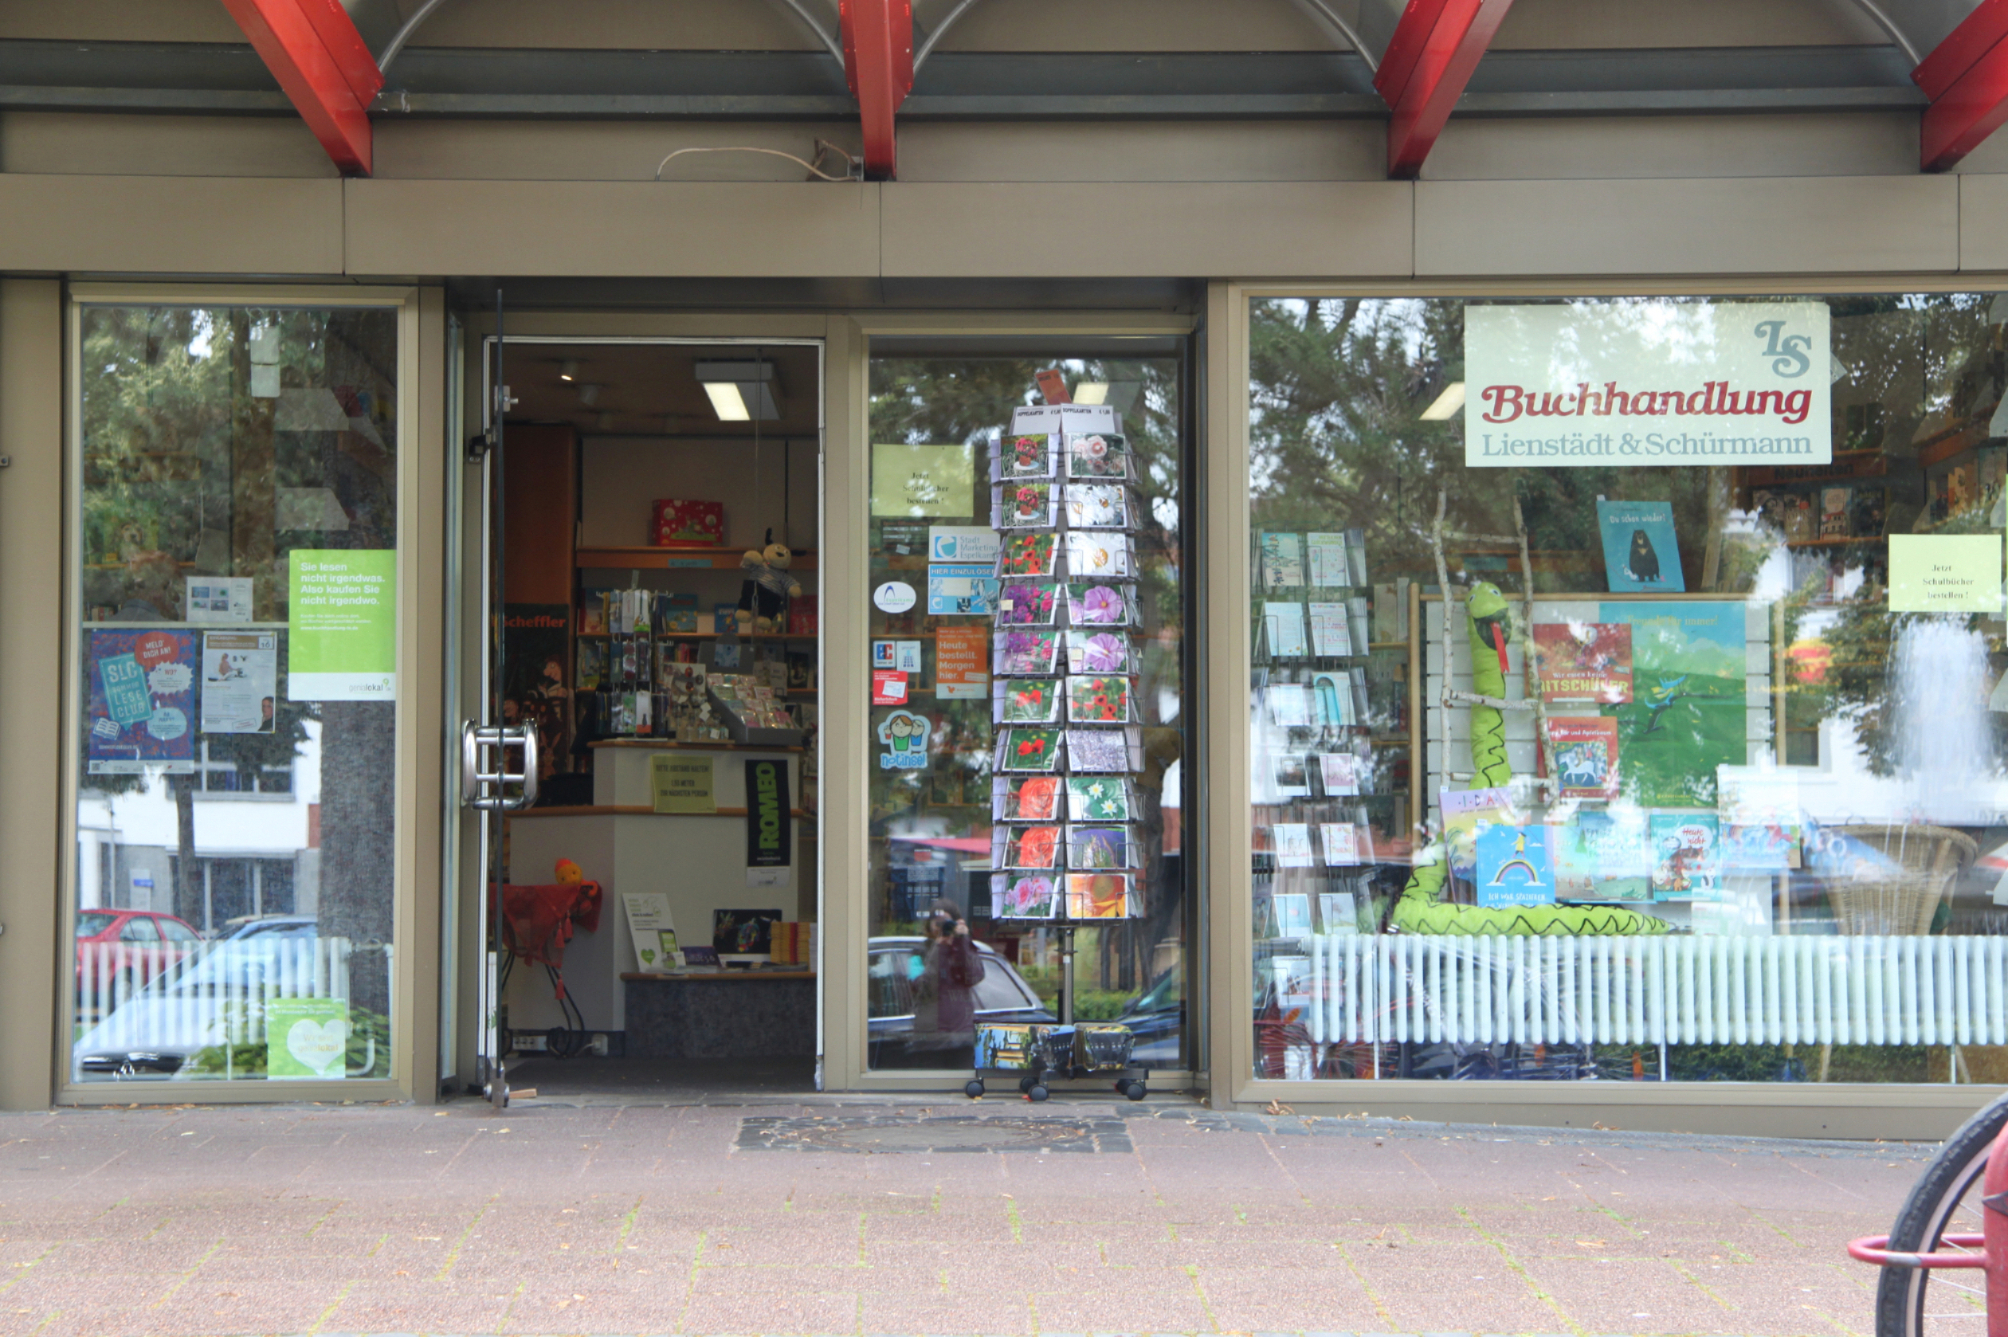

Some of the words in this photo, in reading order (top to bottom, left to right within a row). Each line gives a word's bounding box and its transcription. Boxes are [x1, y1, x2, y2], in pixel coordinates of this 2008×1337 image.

[1481, 381, 1812, 424] Buchhandlung
[1482, 433, 1615, 456] Lienstädt
[1619, 433, 1643, 456] &
[1645, 432, 1813, 456] Schürmann
[911, 472, 929, 480] Jetzt
[1621, 514, 1640, 523] schon
[1641, 512, 1666, 522] wieder!
[960, 535, 980, 544] Stadt
[960, 543, 999, 553] Marketing
[300, 562, 317, 571] Sie
[319, 562, 347, 571] lesen
[1931, 564, 1952, 572] Jetzt
[301, 573, 327, 582] nicht
[329, 573, 385, 584] irgendwas.
[1922, 577, 1974, 585] Schulbücher
[300, 585, 324, 594] Also
[326, 585, 361, 594] kaufen
[363, 585, 380, 594] Sie
[1927, 591, 1963, 599] bestellen
[301, 596, 327, 605] nicht
[329, 596, 380, 607] irgendwo.
[504, 615, 566, 628] Scheffler
[1684, 615, 1719, 626] immer!
[939, 641, 968, 650] Heute
[143, 648, 161, 659] DICH
[160, 646, 172, 656] AN!
[939, 651, 978, 659] bestellt.
[939, 661, 975, 671] Morgen
[108, 661, 138, 682] SLC
[939, 671, 959, 679] hier.
[1552, 671, 1565, 679] Wir
[349, 683, 384, 693] genialokal
[114, 690, 143, 705] LESE
[117, 702, 146, 718] CLUB
[881, 752, 927, 768] notinsel
[755, 762, 780, 849] ROMEO
[1682, 828, 1704, 837] Heute
[1687, 835, 1706, 845] nicht
[304, 1034, 315, 1042] Wir
[298, 1044, 339, 1054] genialokal
